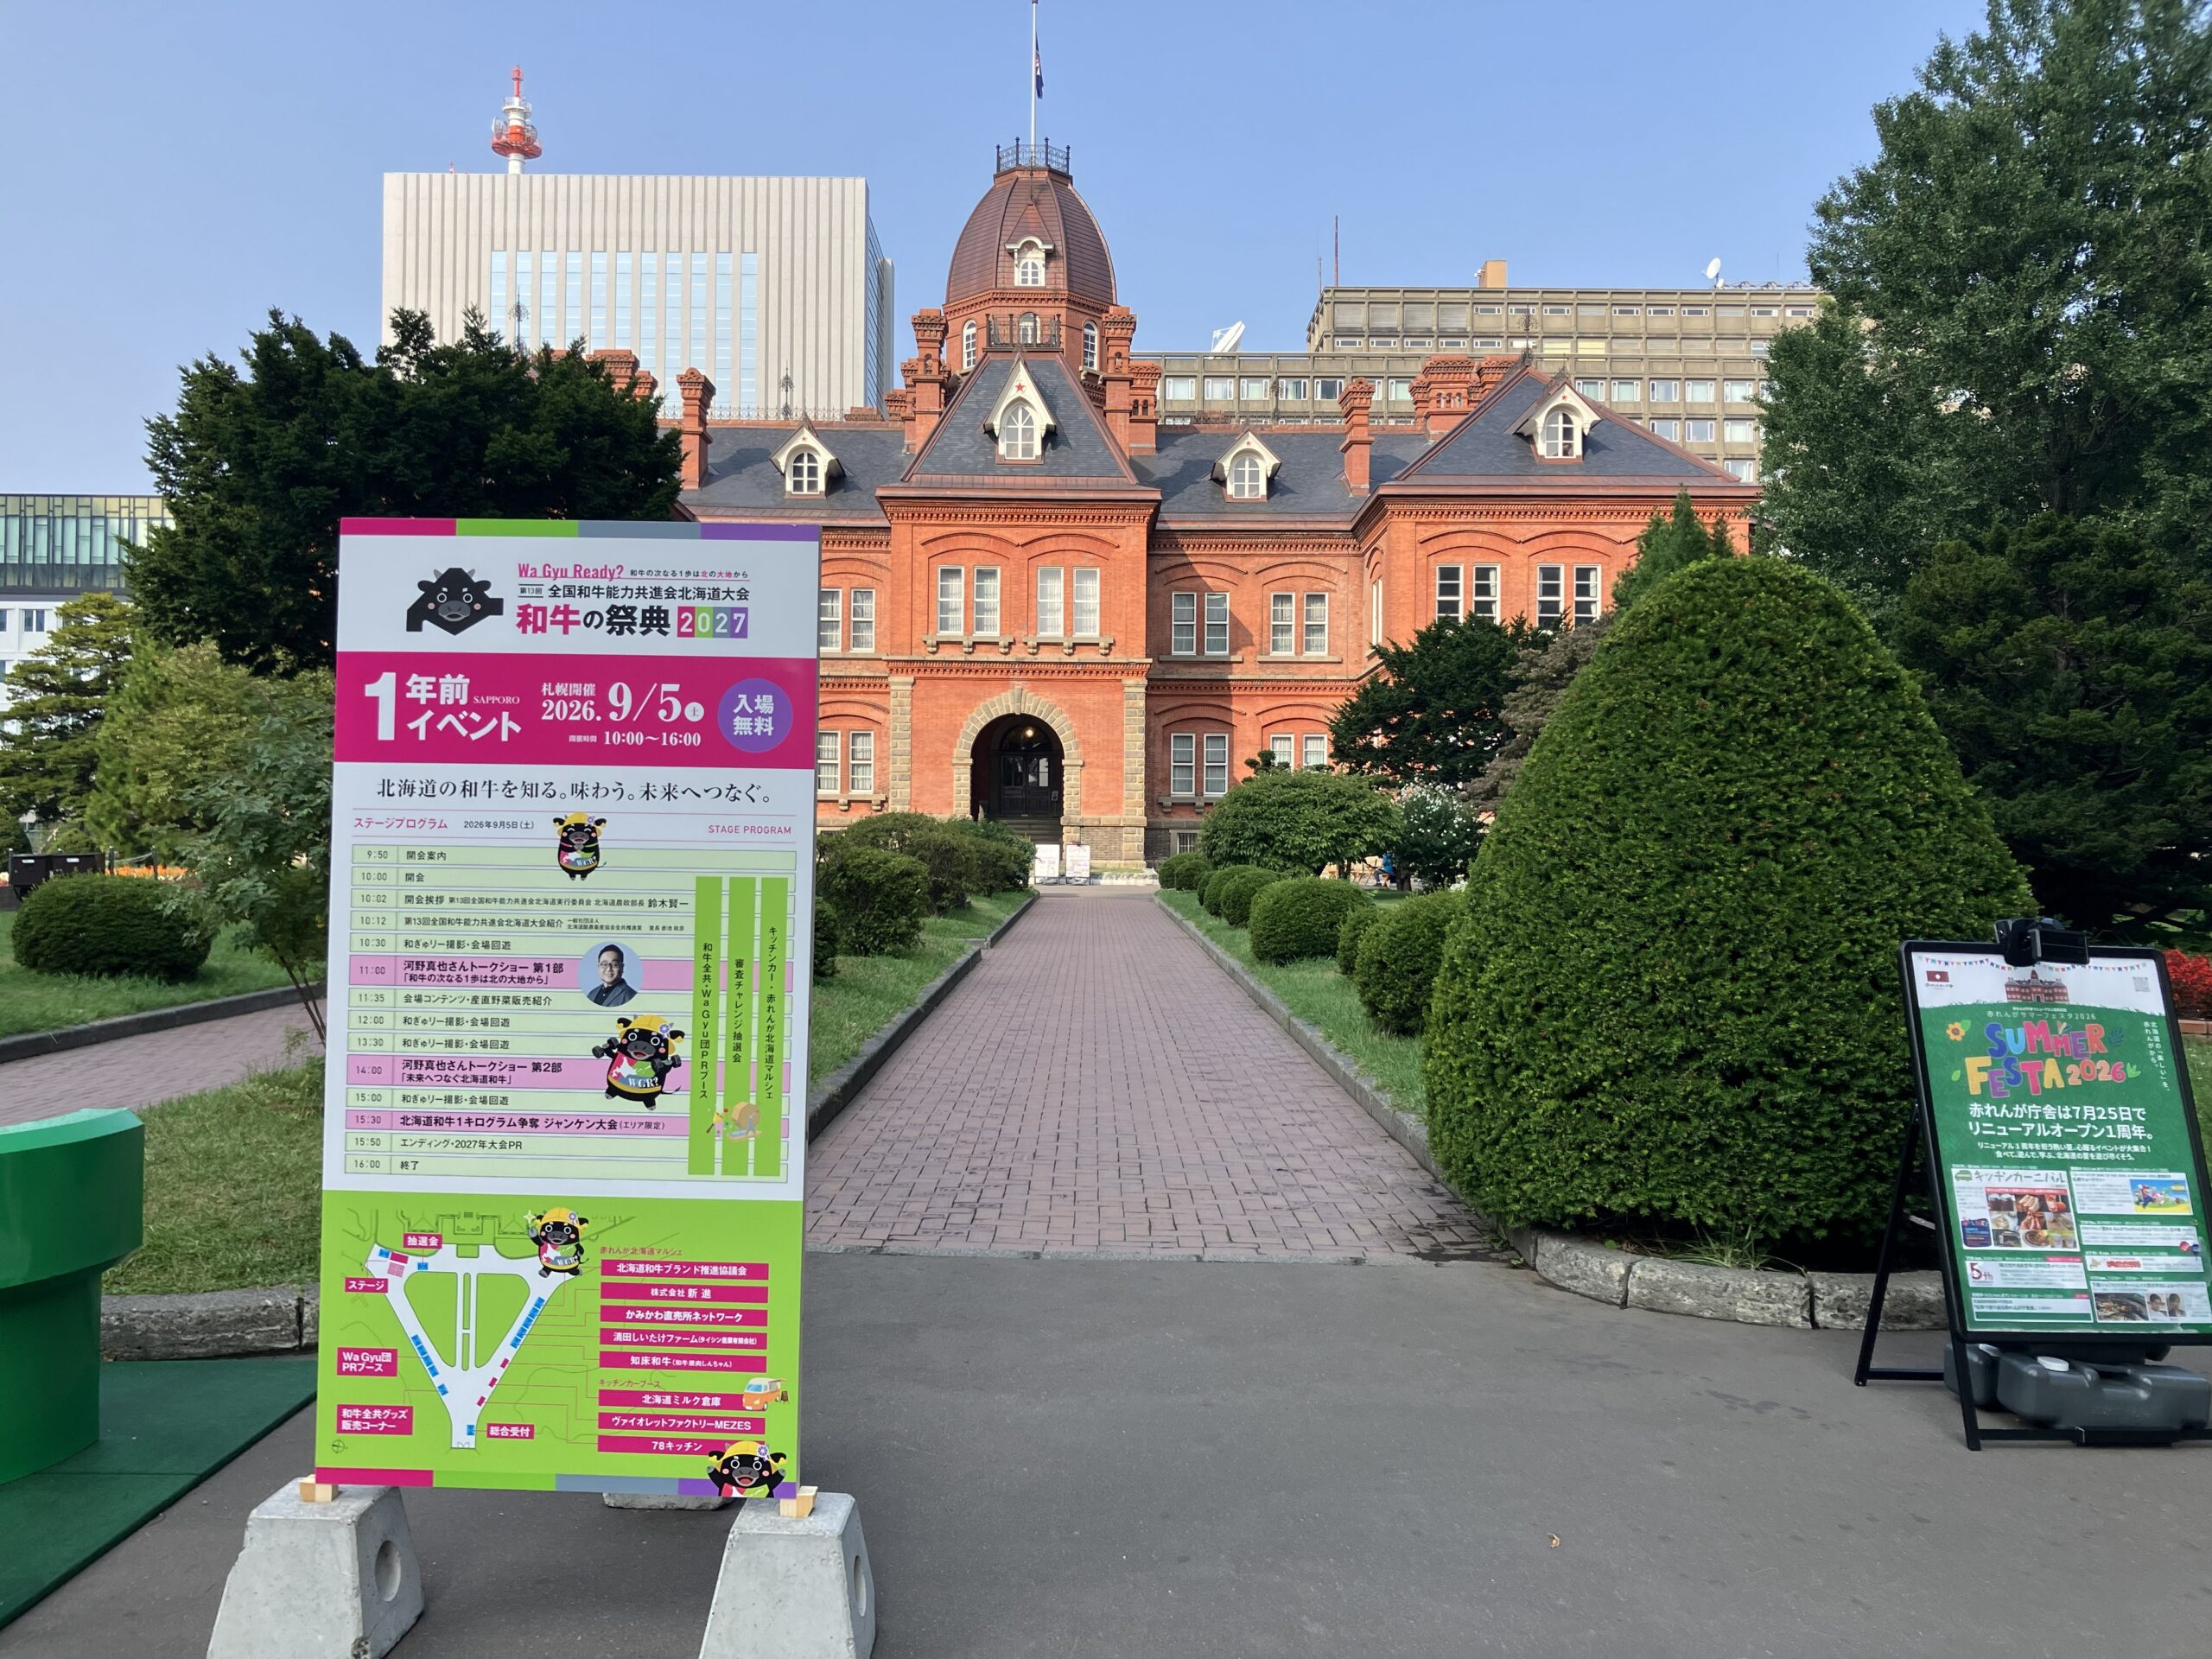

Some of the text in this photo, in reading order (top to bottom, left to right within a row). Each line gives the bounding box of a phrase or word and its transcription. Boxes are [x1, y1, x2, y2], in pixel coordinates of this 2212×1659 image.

[518, 563, 624, 582] Wa Gyu Ready?
[630, 569, 749, 579] 和牛の次なる1歩は北の大地から
[519, 584, 750, 601] 第13回 全国和牛能力共進会北海道大会
[516, 603, 747, 637] 和牛の祭典 2027
[405, 673, 520, 705] 年前 SAPPORO
[541, 683, 596, 696] 札幌開催
[365, 672, 397, 741] 1
[541, 700, 602, 721] 2026.
[608, 682, 682, 722] 9/5
[733, 694, 775, 715] 入場
[407, 709, 522, 742] イベント
[733, 715, 774, 736] 無料
[377, 779, 770, 803] 北海道の和牛を知る。味わう。未来へつなぐ。
[353, 817, 448, 830] ステージプログラム
[709, 825, 791, 835] STAGE PROGRAM
[366, 850, 447, 861] 9:50 開会案内
[361, 873, 425, 882] 10:00 開会
[361, 894, 387, 903] 10:02
[404, 895, 445, 905] 開会挨拶
[360, 916, 386, 925] 10:12
[359, 938, 386, 947] 10:30
[359, 960, 564, 975] 11:00 河野真也さんトークショー 第1部
[359, 994, 385, 1002] 11:35
[358, 1015, 385, 1025] 12:00
[357, 1038, 384, 1047] 13:30
[1985, 1020, 2108, 1060] SUMMER
[356, 1059, 563, 1075] 14:00 河野真也さんトークショー 第2部
[1965, 1056, 2127, 1098] FESTA 2026
[355, 1093, 382, 1103] 15:00
[1969, 1103, 2147, 1122] 赤れんが庁舎は7月25日で
[354, 1115, 382, 1124] 15:30
[1968, 1122, 2153, 1140] リニューアルオープン1周年。
[354, 1137, 381, 1147] 15:50
[353, 1159, 419, 1171] 16:00 終了
[407, 1236, 439, 1246] 抽選会
[347, 1280, 385, 1291] ステージ
[651, 1287, 685, 1298] 株式会社
[626, 1310, 743, 1322] かみかわ直売所ネットワーク
[342, 1351, 391, 1363] Wa Gyu団
[342, 1362, 384, 1373] PRブース
[642, 1394, 721, 1407] 北海道ミルク倉庫
[341, 1408, 408, 1420] 和牛全共グッズ
[341, 1421, 397, 1431] 販売コーナー
[612, 1415, 752, 1430] ヴァイオレットファクトリーMEZES
[489, 1426, 531, 1438] 総合受付
[652, 1440, 702, 1452] 78キッチン
